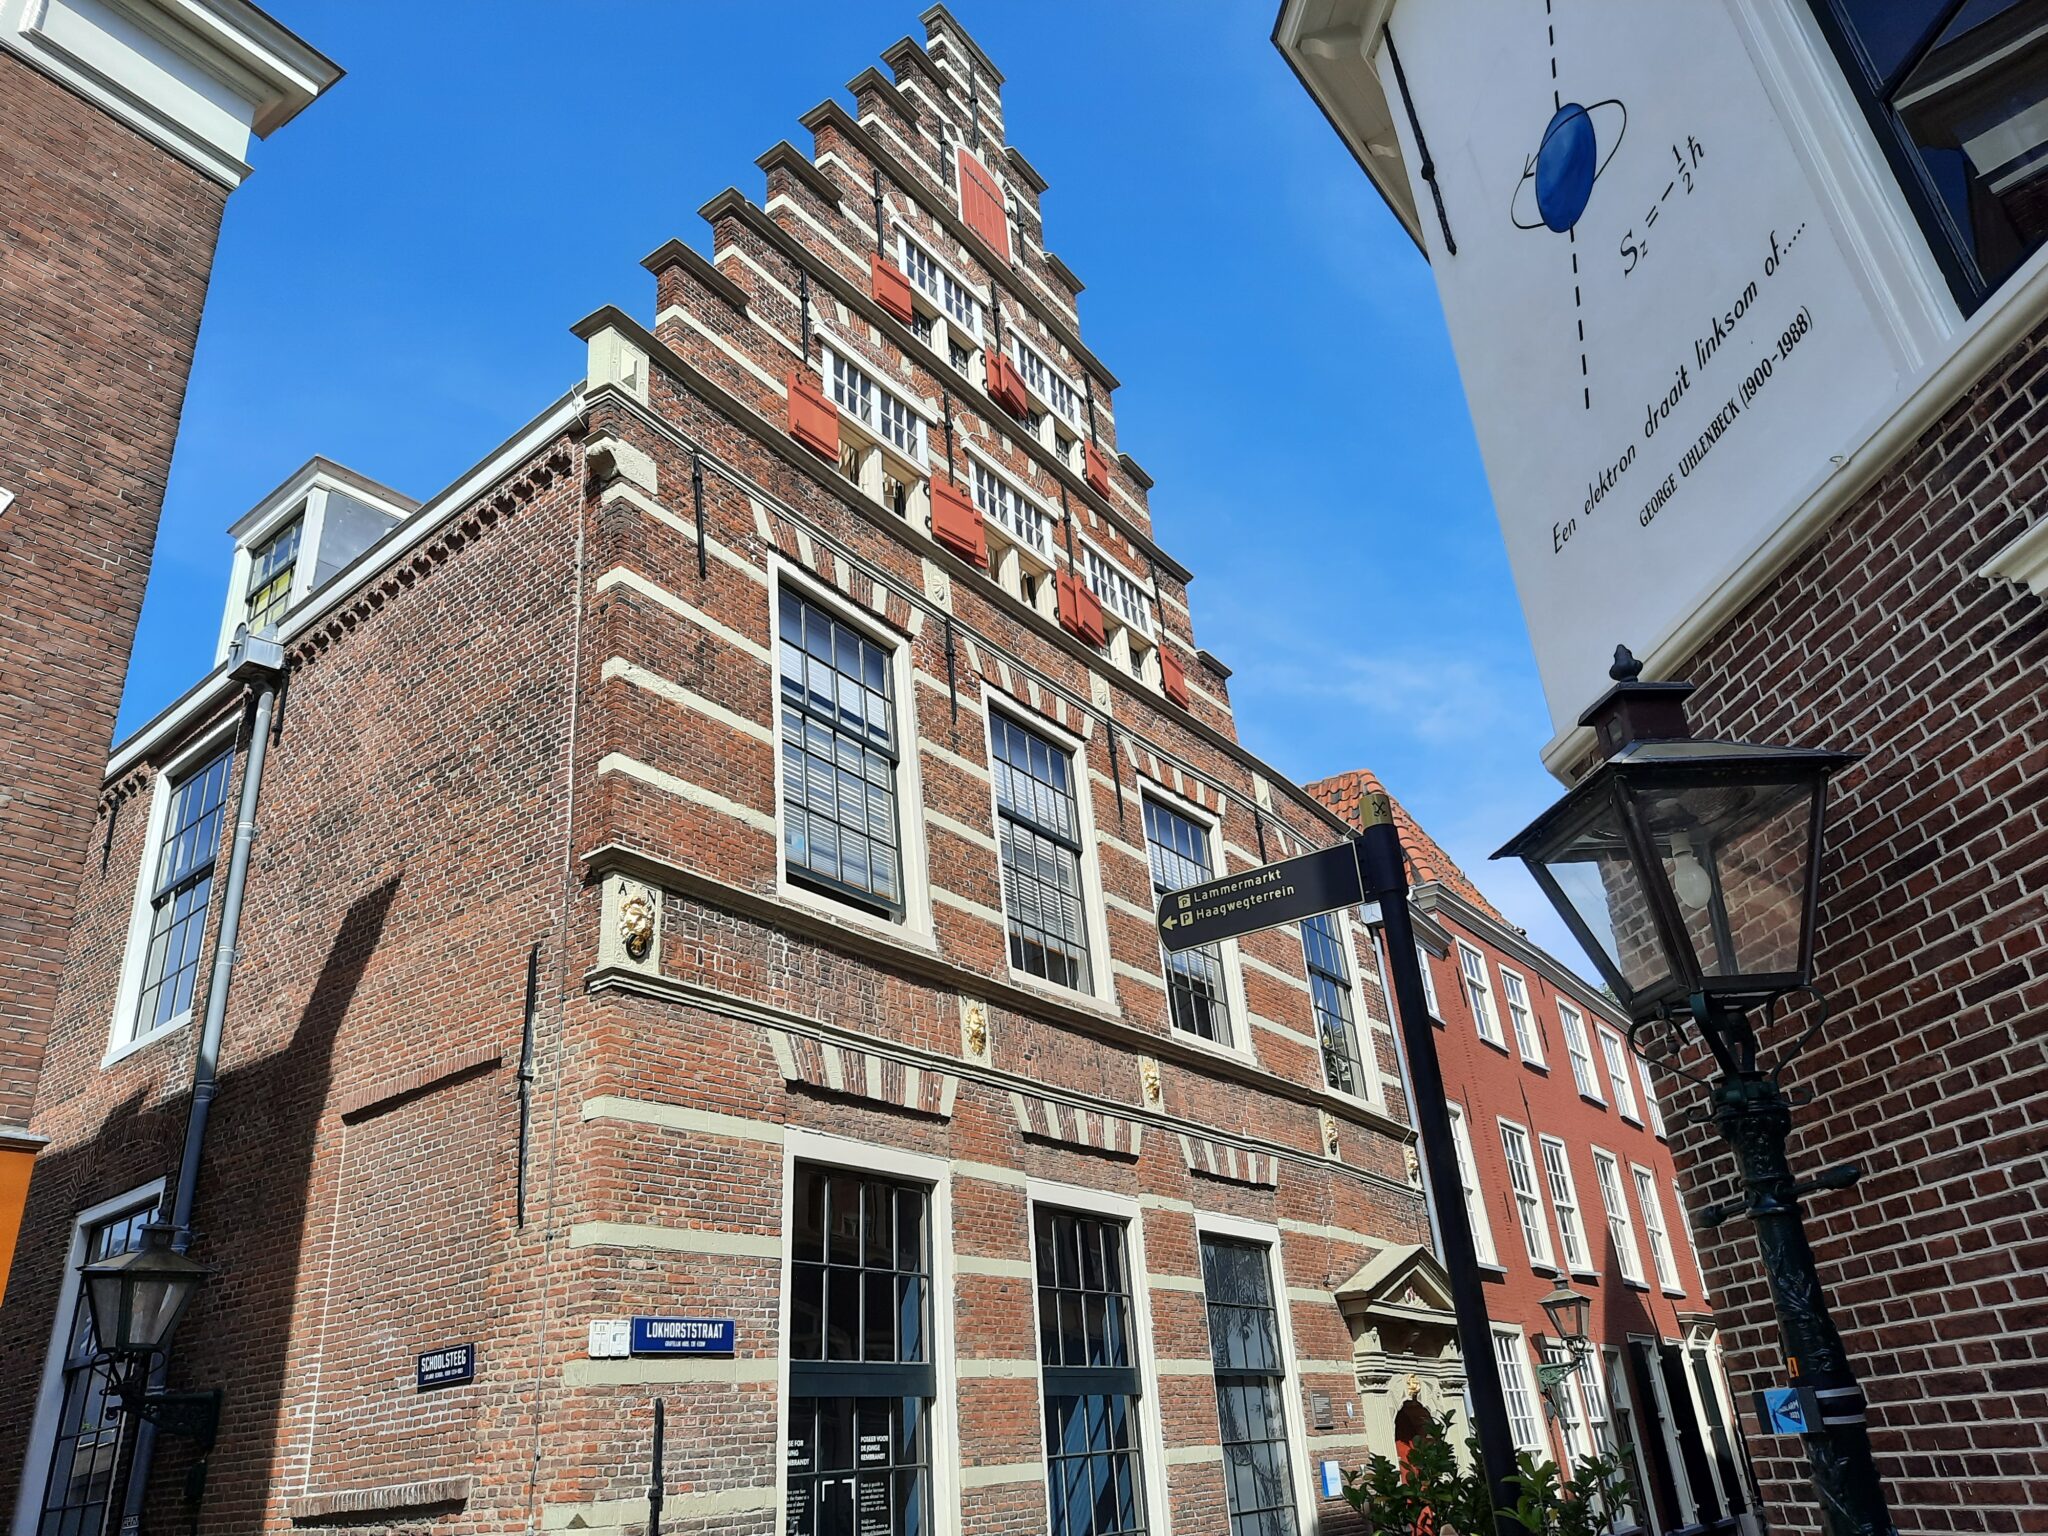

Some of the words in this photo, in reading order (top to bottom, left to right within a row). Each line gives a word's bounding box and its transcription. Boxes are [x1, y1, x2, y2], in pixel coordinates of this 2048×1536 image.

[1552, 518, 1577, 555] Een
[1584, 443, 1637, 516] elektron
[1644, 364, 1691, 438] draait
[1694, 280, 1759, 371] linksom
[1639, 477, 1679, 528] GEORGE
[1678, 401, 1740, 478] UHLENBECK
[1737, 305, 1814, 411] (1900-1988)
[1194, 869, 1282, 903] Lammermarkt
[1196, 885, 1295, 920] Haagwegterrein
[646, 1322, 724, 1338] LOKHORSTSTRAAT
[421, 1349, 466, 1372] SCHOOLSTEEG
